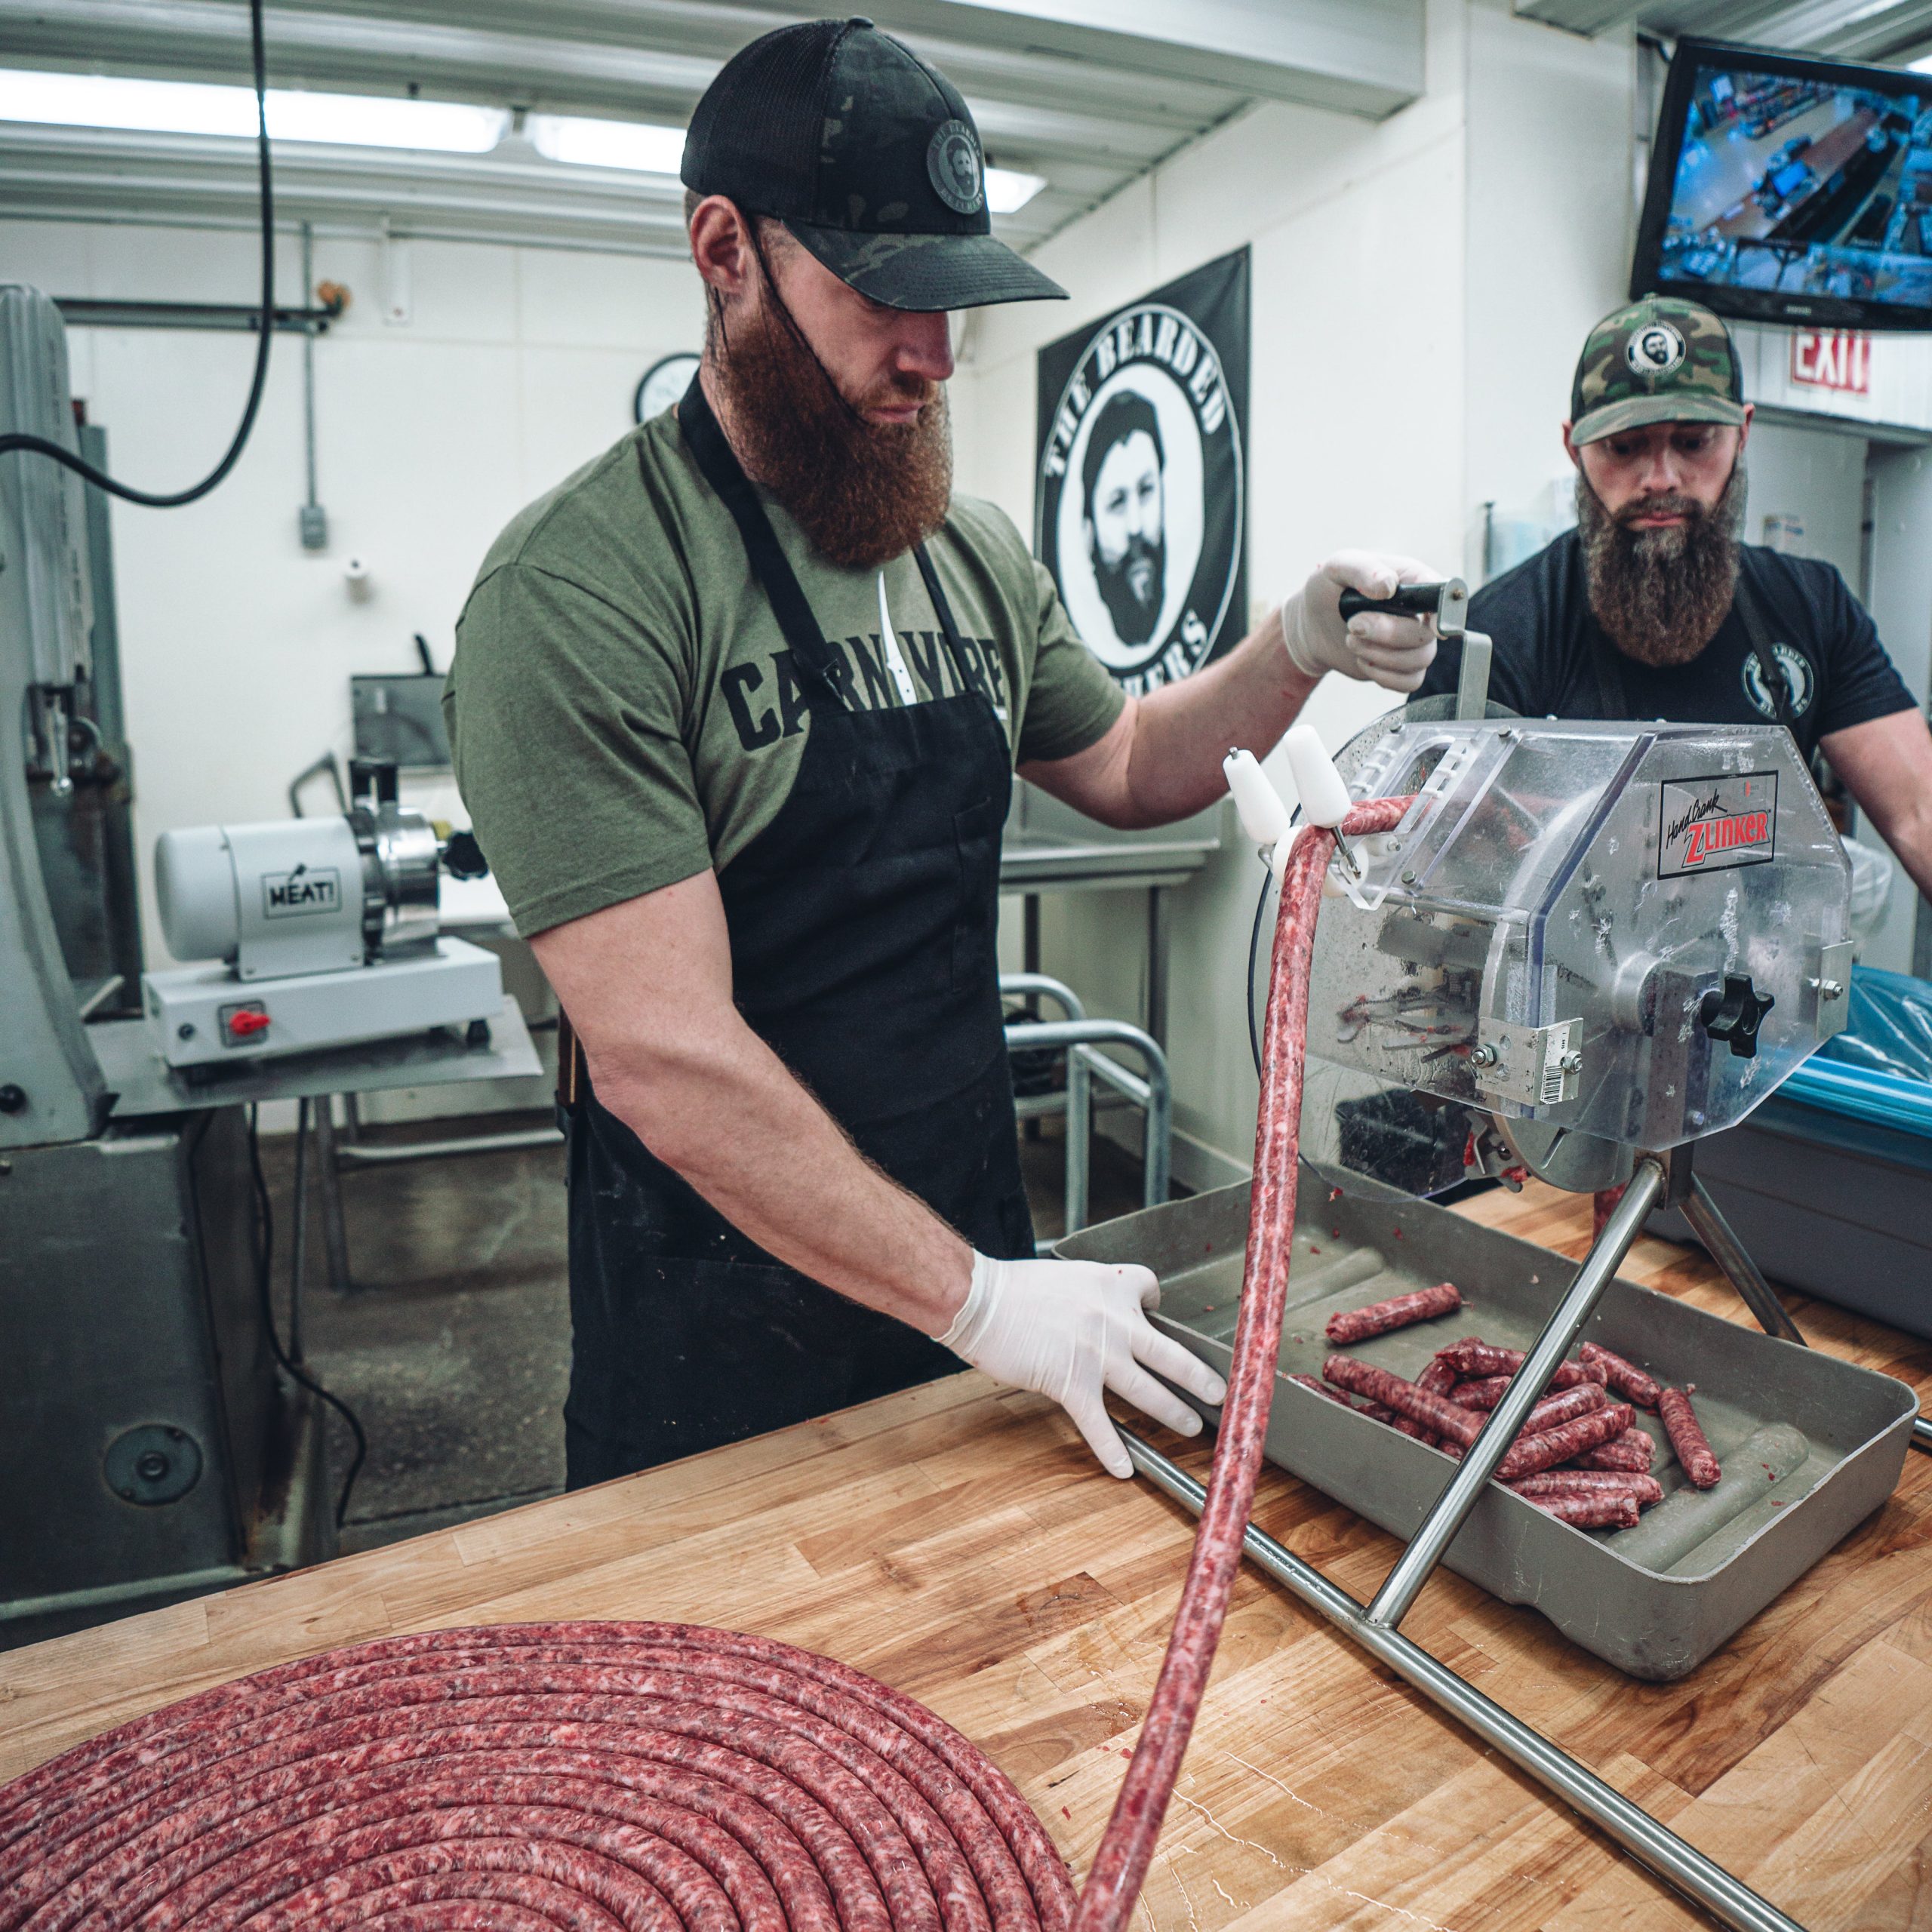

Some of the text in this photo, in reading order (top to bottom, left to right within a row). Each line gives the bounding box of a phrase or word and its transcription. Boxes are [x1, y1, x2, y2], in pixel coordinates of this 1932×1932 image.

[1044, 312, 1226, 477] THE BEARDED
[1666, 788, 1728, 850] Hand Crank
